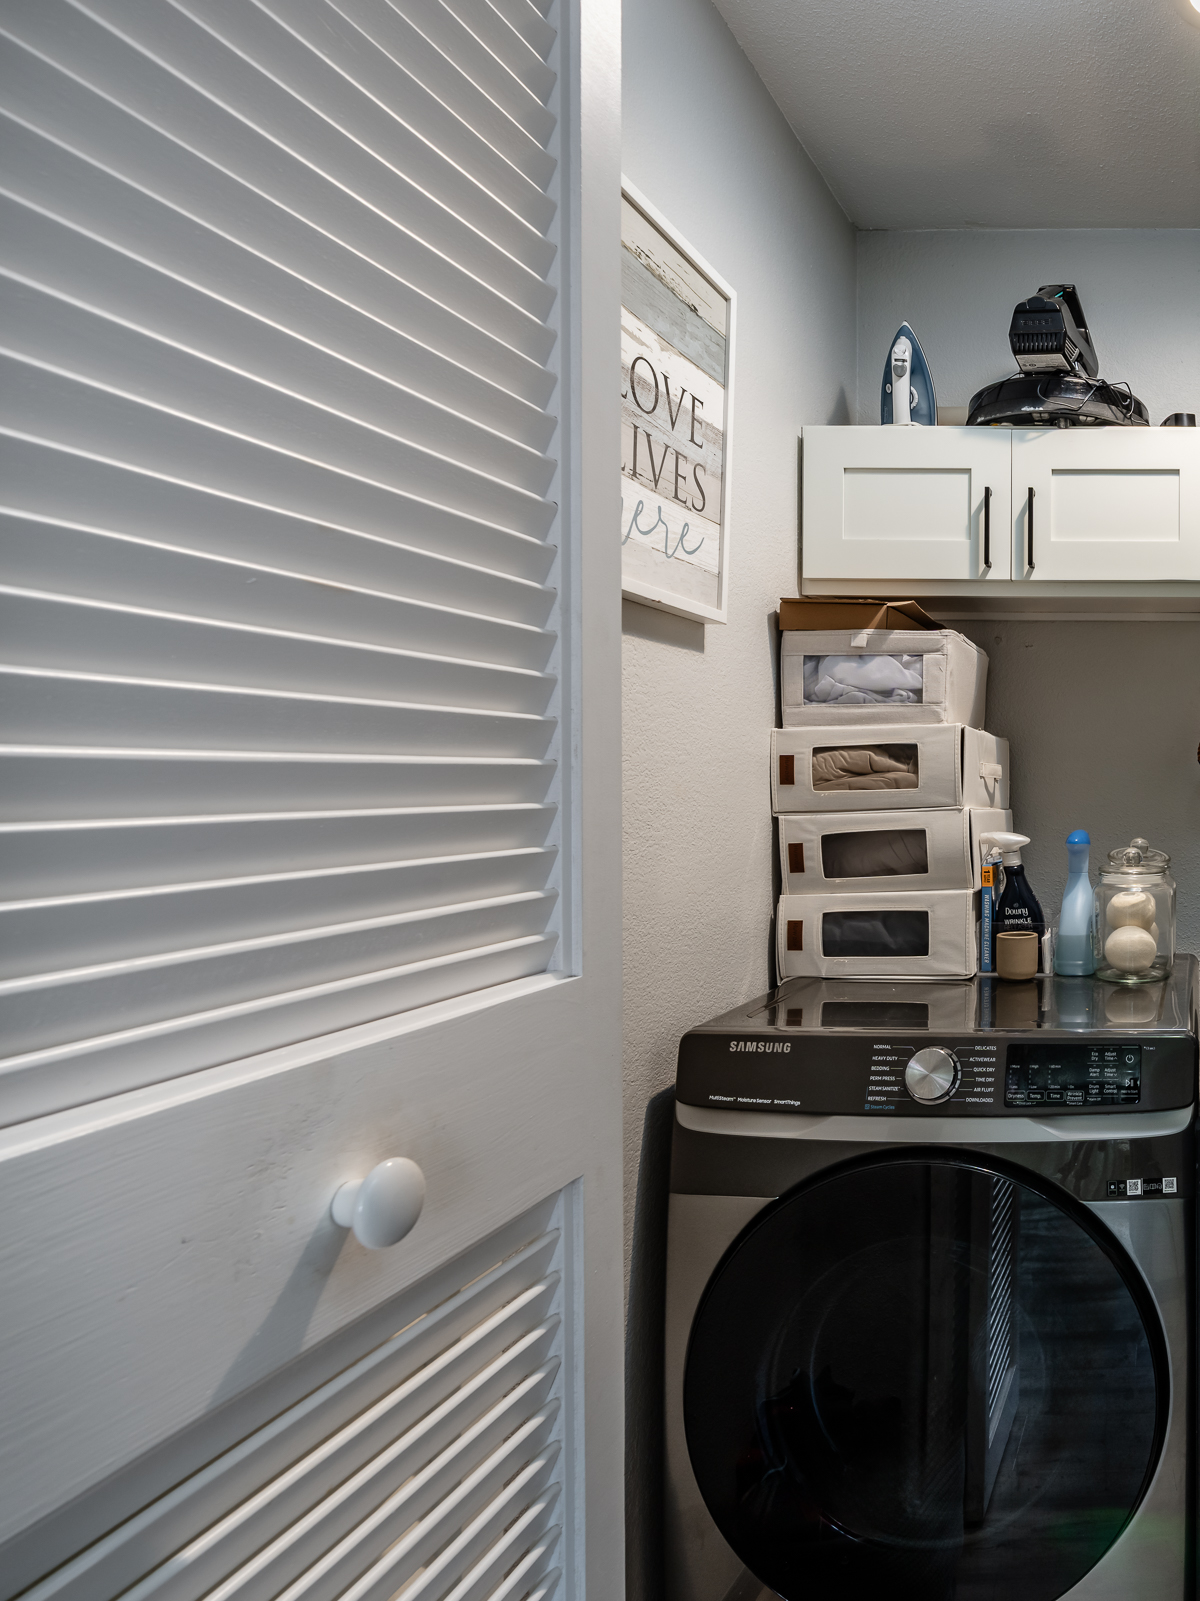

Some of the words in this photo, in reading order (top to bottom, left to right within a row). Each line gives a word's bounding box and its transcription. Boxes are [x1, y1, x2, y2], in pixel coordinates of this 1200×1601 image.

[621, 356, 703, 449] OVE
[621, 422, 705, 512] IVES
[621, 496, 704, 559] ere
[1004, 917, 1032, 925] WRINKLE
[1005, 907, 1028, 917] Downy
[729, 1041, 791, 1053] SAMSUNG
